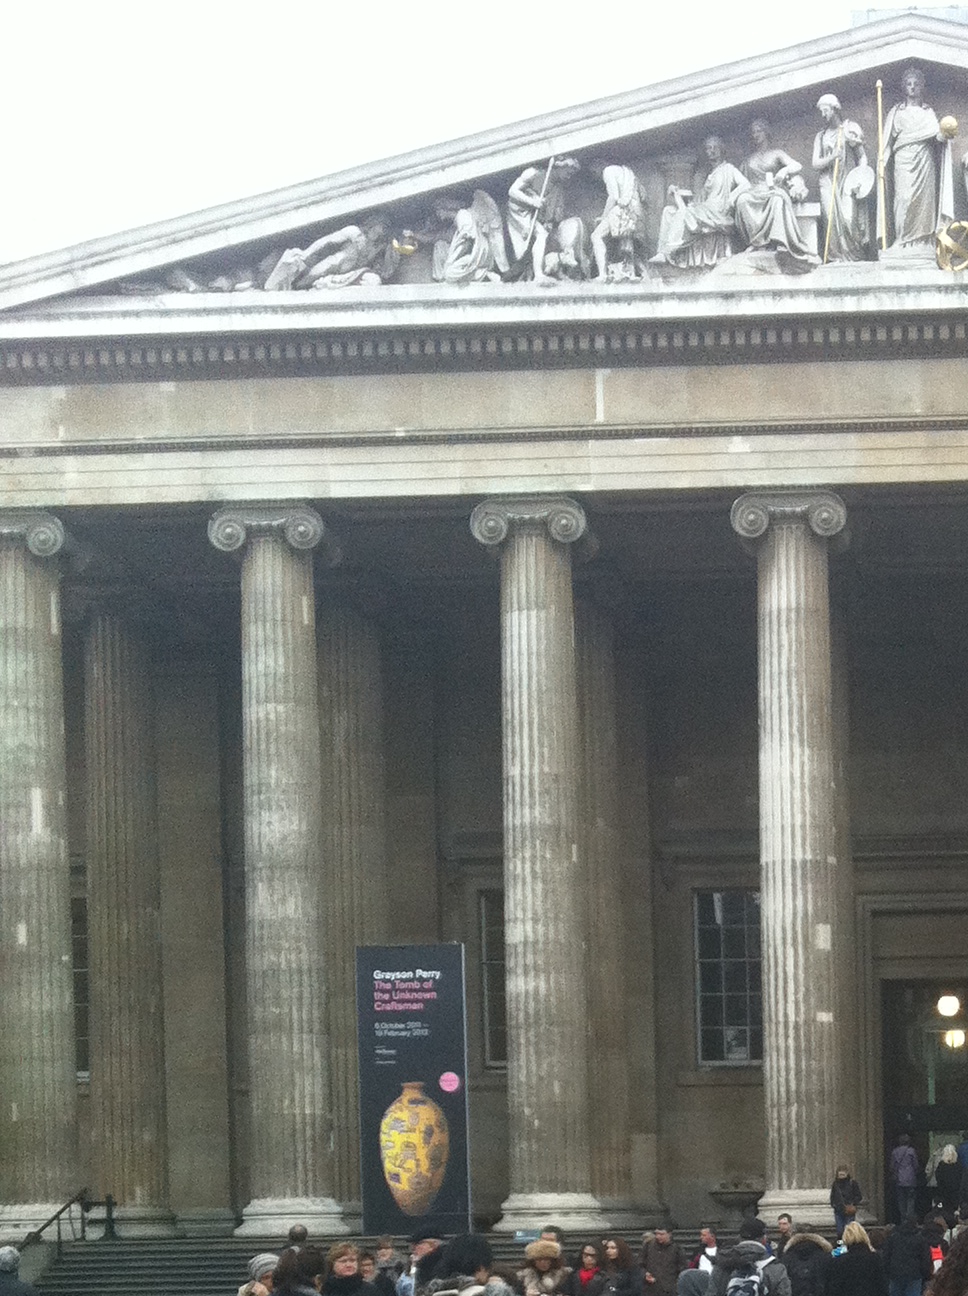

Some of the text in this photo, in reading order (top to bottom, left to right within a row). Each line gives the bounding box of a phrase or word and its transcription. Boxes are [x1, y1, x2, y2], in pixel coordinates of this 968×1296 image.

[373, 968, 441, 980] Grayson Perry
[374, 979, 433, 989] The Tomb of
[374, 990, 437, 1000] the Unknown
[374, 1001, 424, 1011] Craftsman
